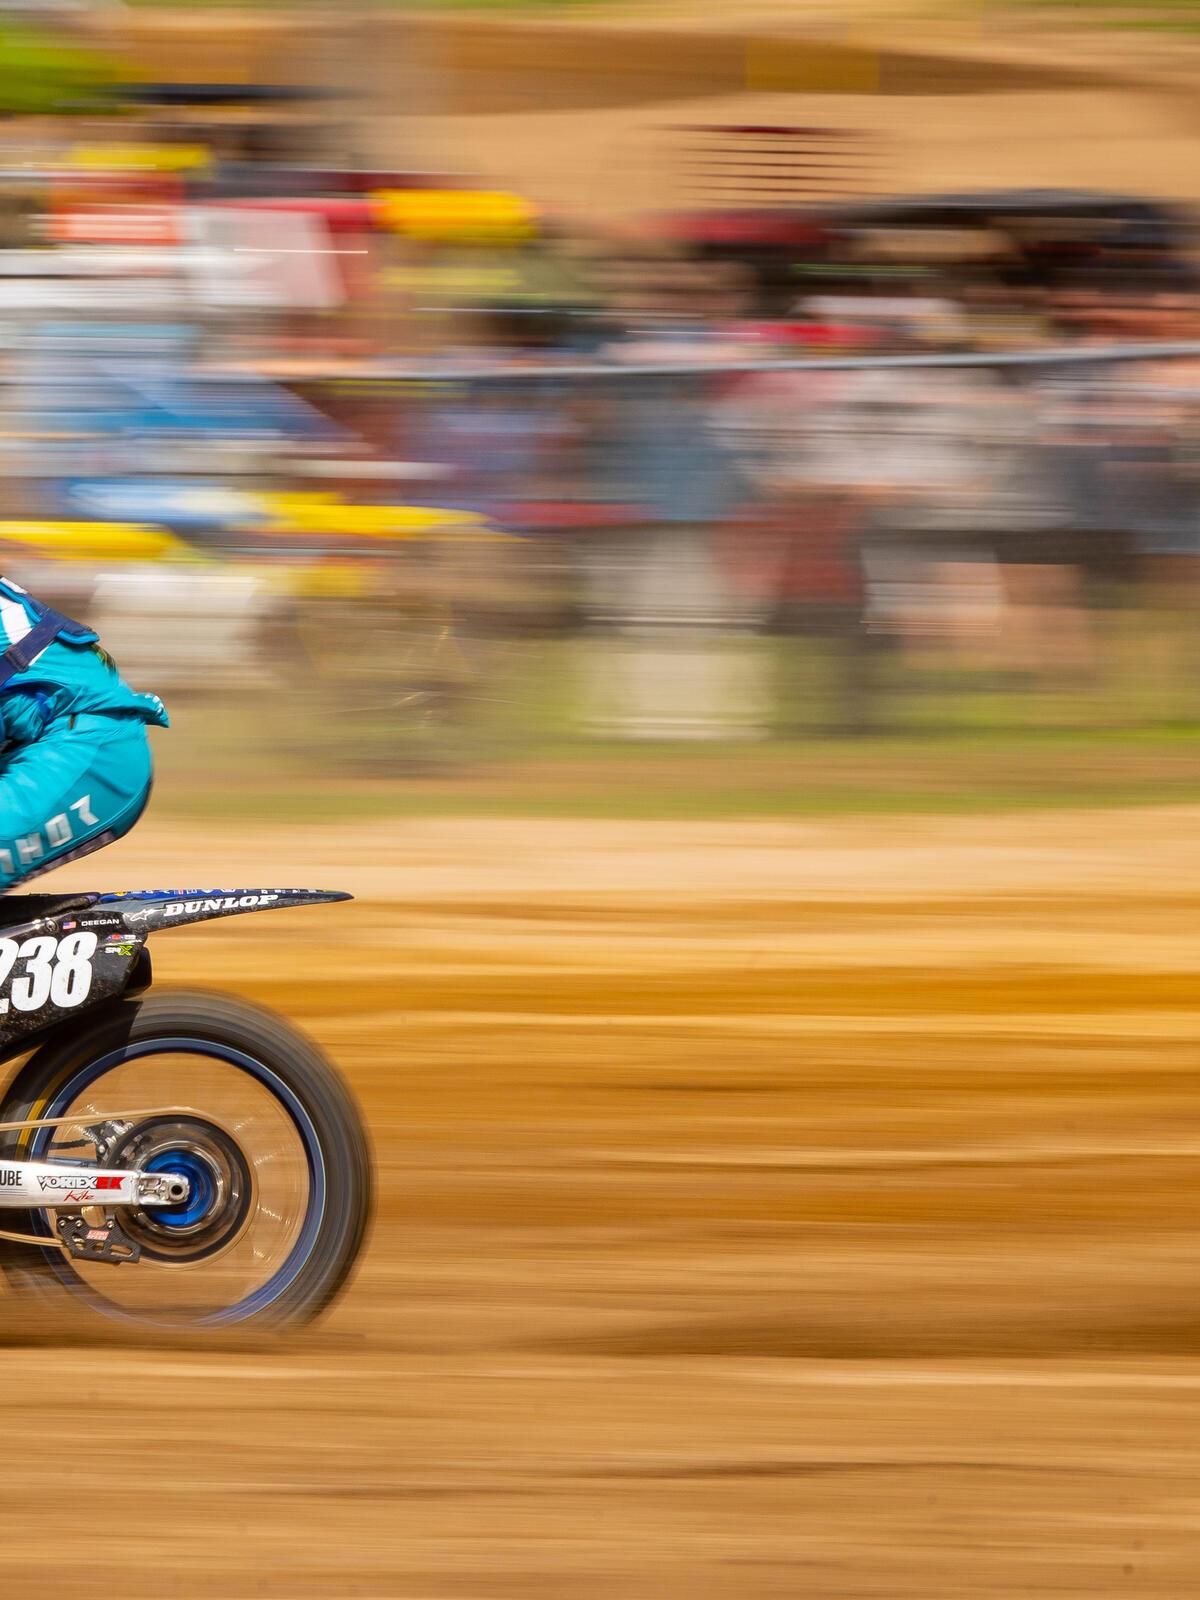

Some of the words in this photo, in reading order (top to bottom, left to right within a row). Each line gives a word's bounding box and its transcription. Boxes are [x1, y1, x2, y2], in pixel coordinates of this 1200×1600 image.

[163, 894, 279, 917] DUNLOP
[81, 918, 120, 927] DEEGAN
[36, 1176, 99, 1192] VORTEX
